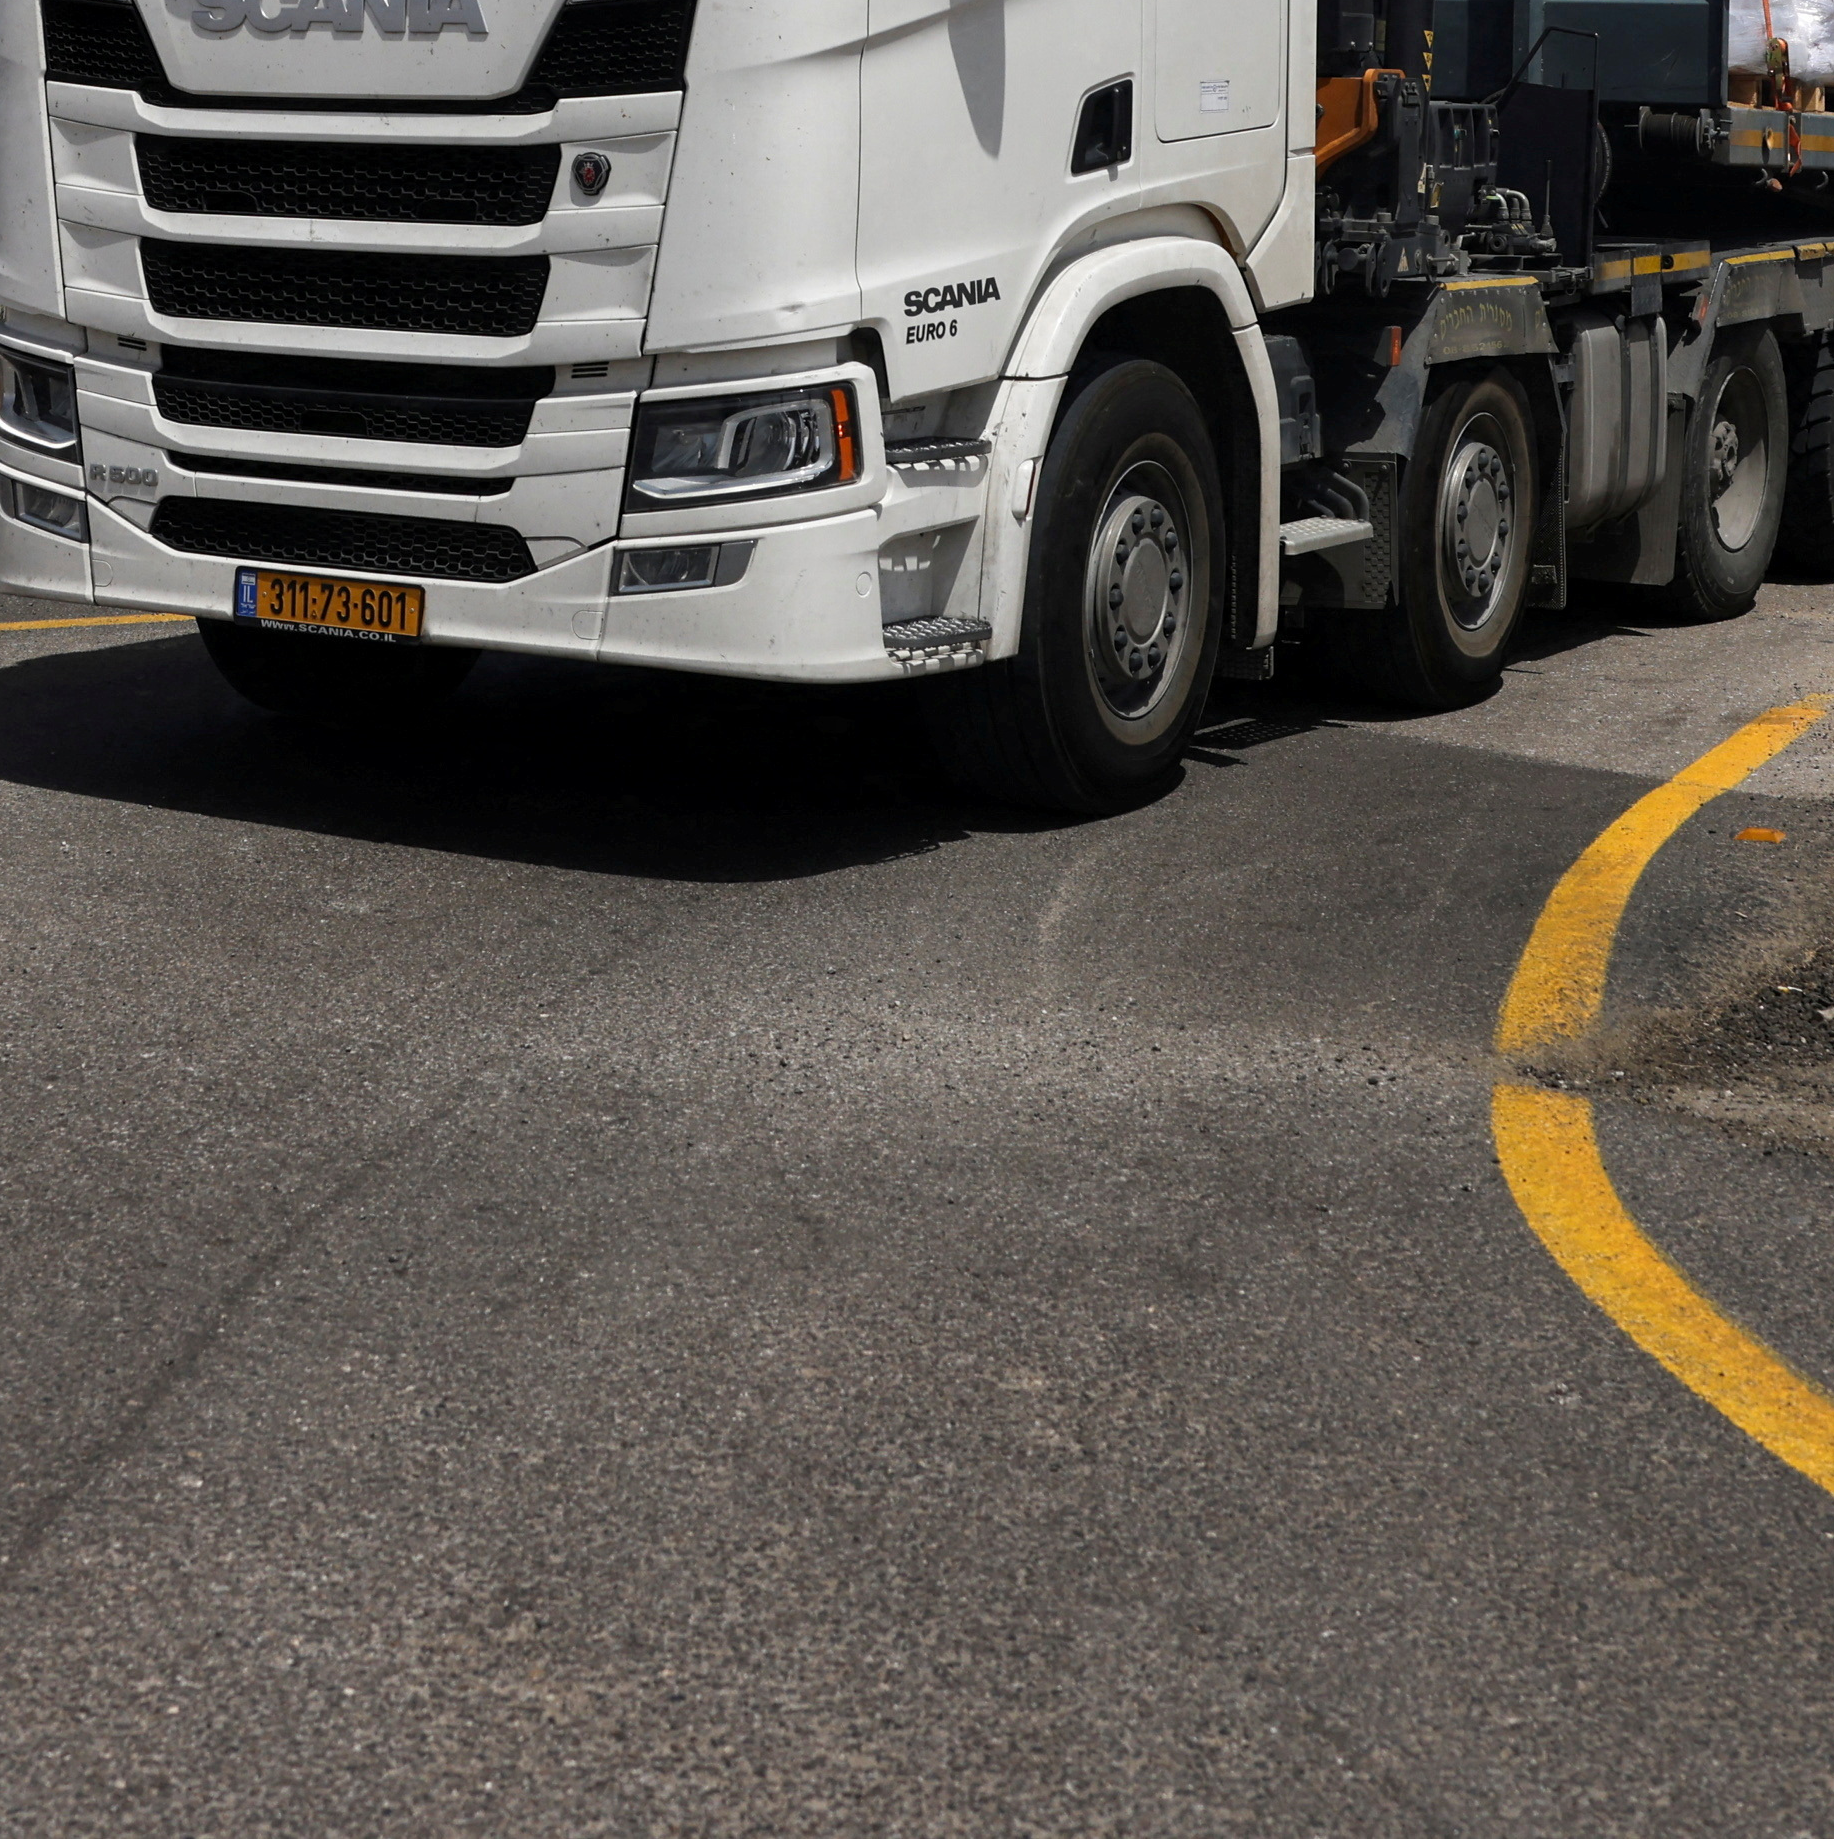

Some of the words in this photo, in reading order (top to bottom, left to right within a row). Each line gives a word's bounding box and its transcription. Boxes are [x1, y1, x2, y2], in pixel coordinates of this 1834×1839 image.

[903, 277, 1001, 317] SCANIA
[906, 321, 947, 345] EURO
[949, 319, 958, 337] 6
[89, 464, 107, 481] R
[109, 466, 159, 487] 500
[243, 585, 254, 604] IL
